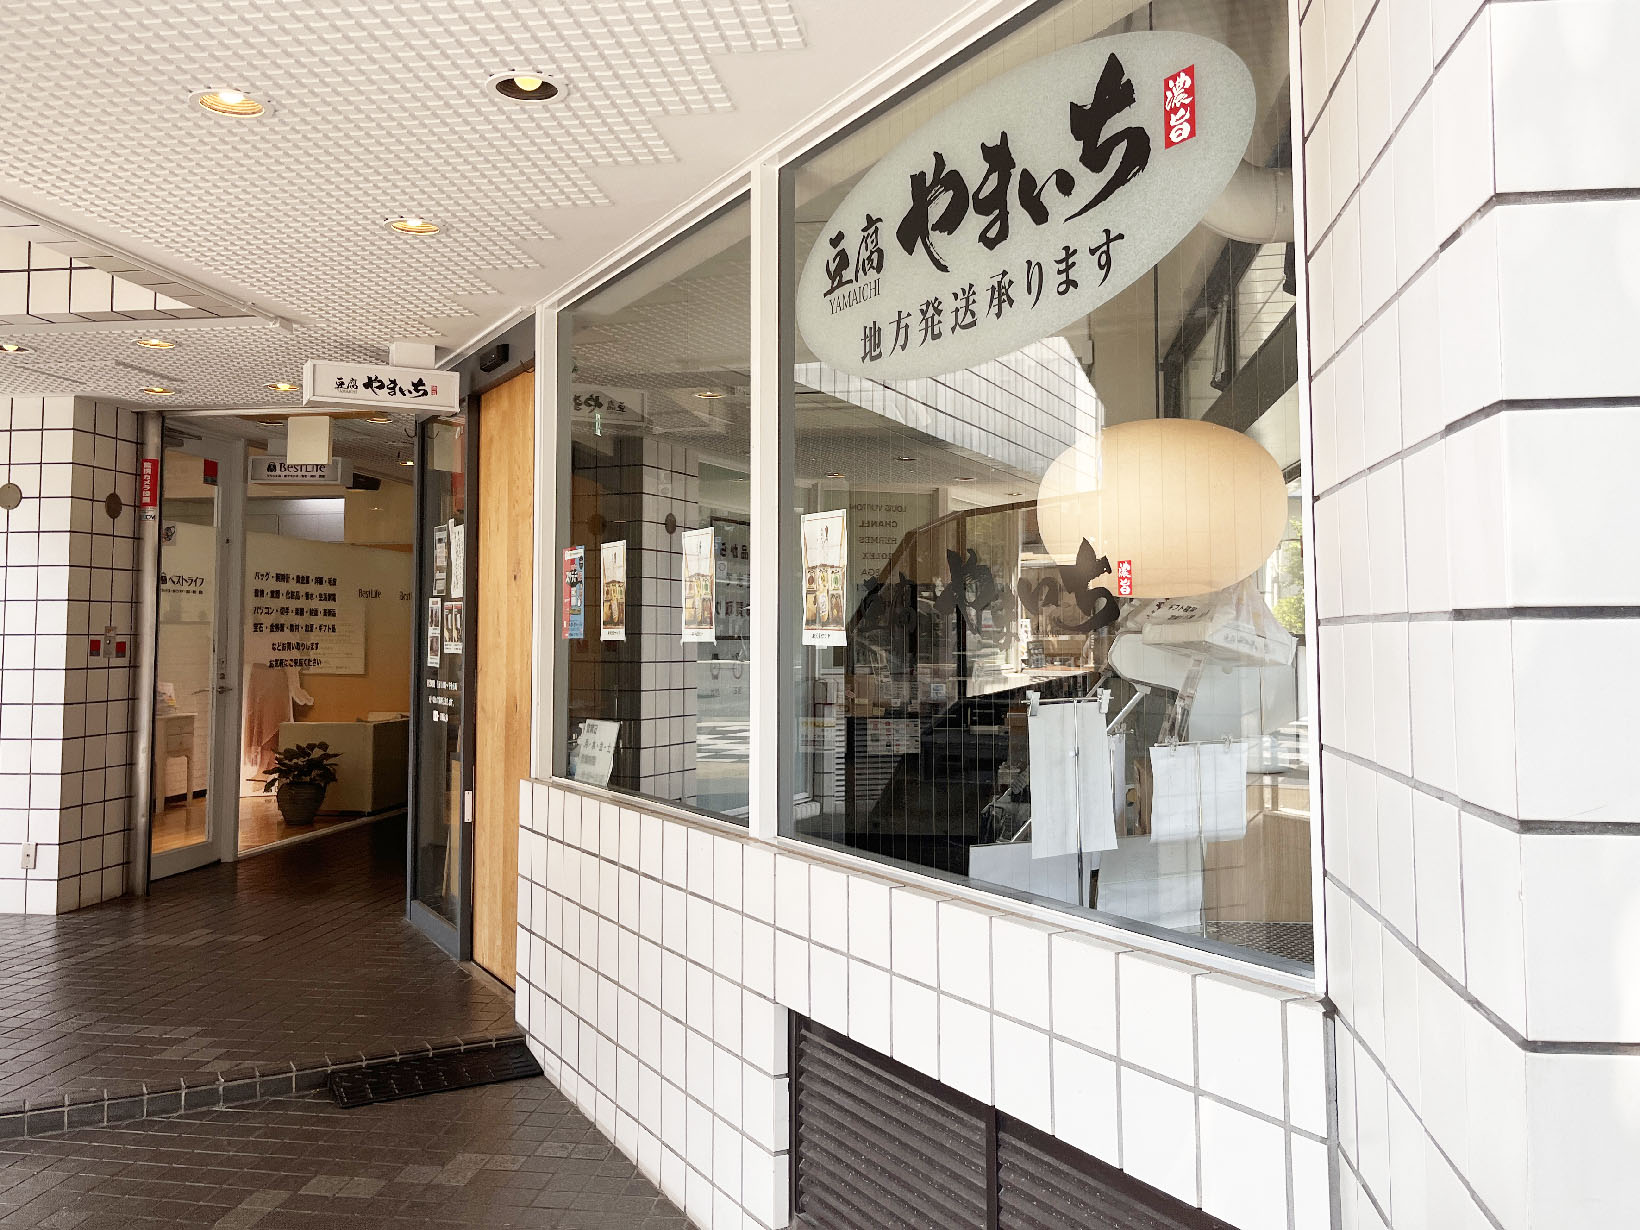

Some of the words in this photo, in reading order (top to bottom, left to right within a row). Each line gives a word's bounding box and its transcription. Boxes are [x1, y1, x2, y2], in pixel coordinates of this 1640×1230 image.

[1165, 70, 1194, 144] 濃旨
[823, 213, 885, 298] 豆腐
[896, 52, 1151, 273] やまいち
[829, 278, 881, 315] YAMAICHI
[860, 228, 1125, 364] 地方発送承ります
[335, 376, 358, 390] 豆腐
[362, 374, 428, 398] やまいち
